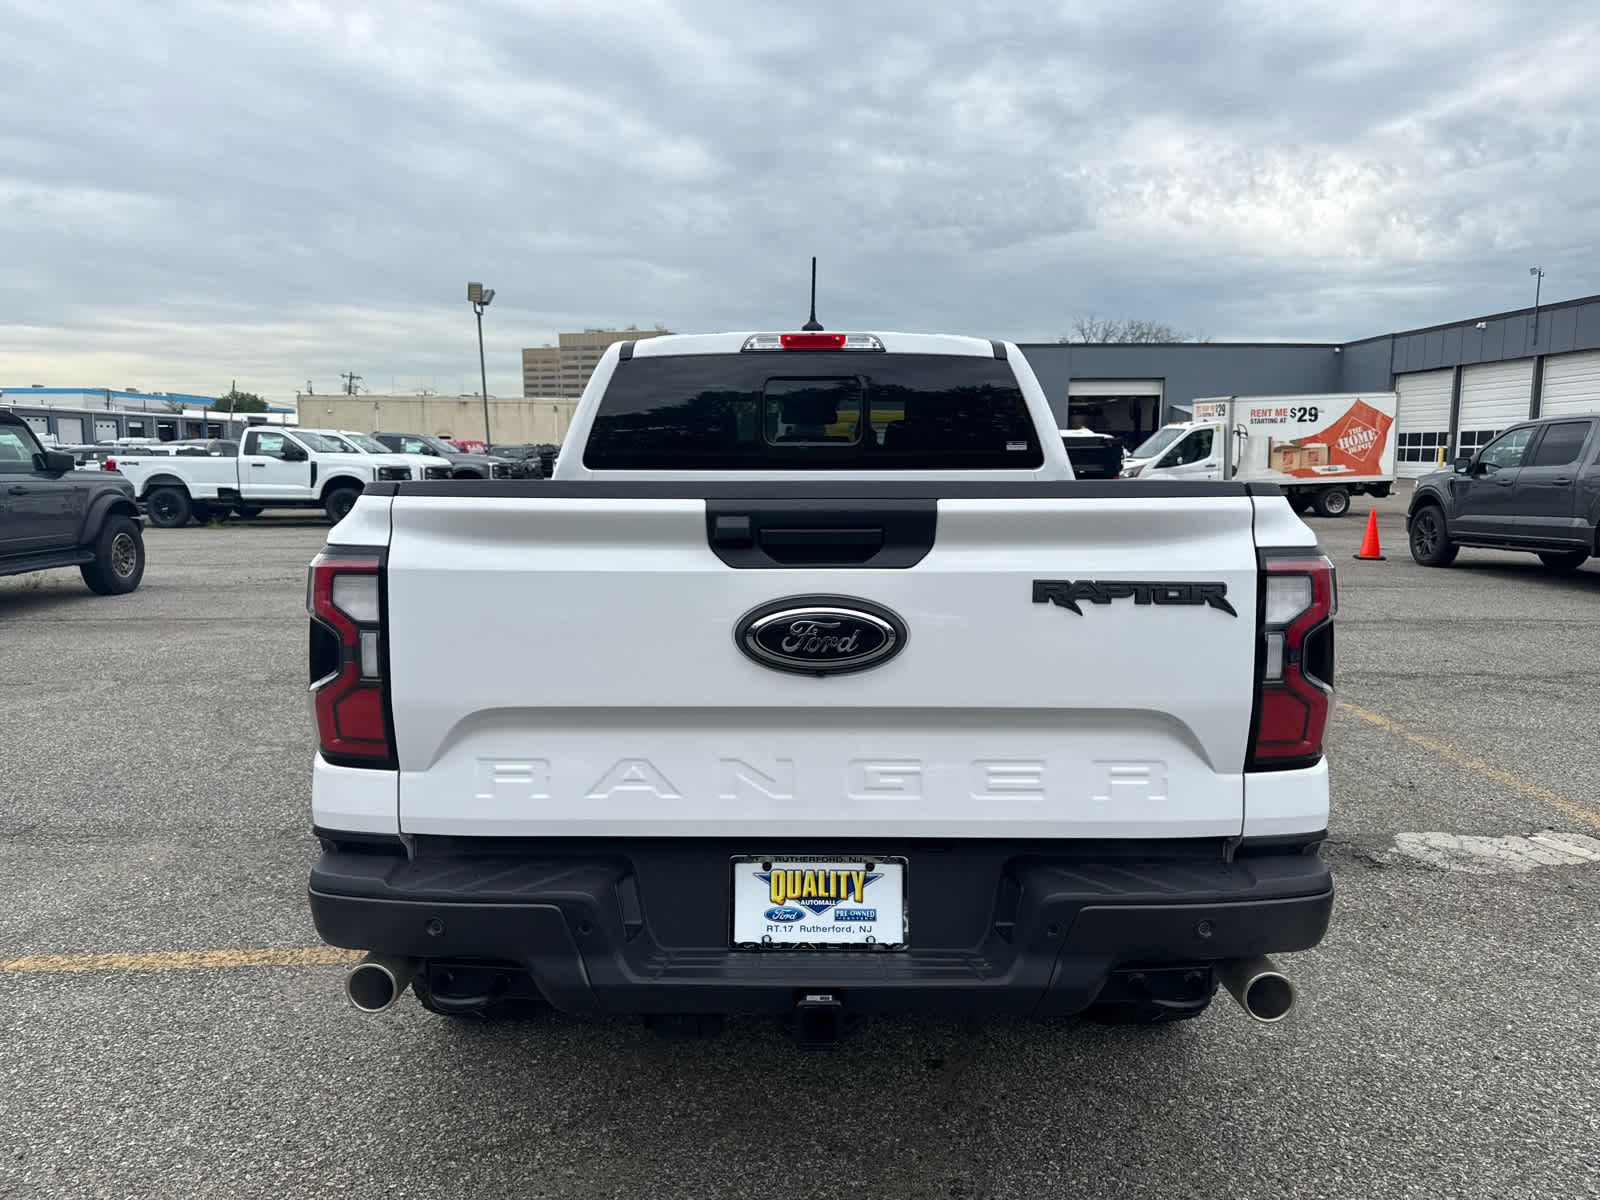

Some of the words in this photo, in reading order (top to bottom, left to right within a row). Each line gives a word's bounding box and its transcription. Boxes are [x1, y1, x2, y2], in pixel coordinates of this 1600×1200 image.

[1250, 408, 1272, 417] RENT
[1275, 408, 1288, 417] ME
[1290, 406, 1319, 423] $29
[1348, 426, 1362, 435] THE
[1338, 429, 1377, 450] HOME
[1347, 442, 1372, 455] DEPOT
[1032, 579, 1238, 618] RAPTOR
[781, 620, 861, 653] Ford
[474, 757, 1169, 802] RANGER
[849, 856, 862, 864] NJ
[769, 869, 866, 905] QUALITY
[771, 908, 797, 921] Ford
[835, 910, 875, 918] PRE-OWNED
[800, 925, 855, 934] Rutherford,
[859, 925, 872, 933] NJ
